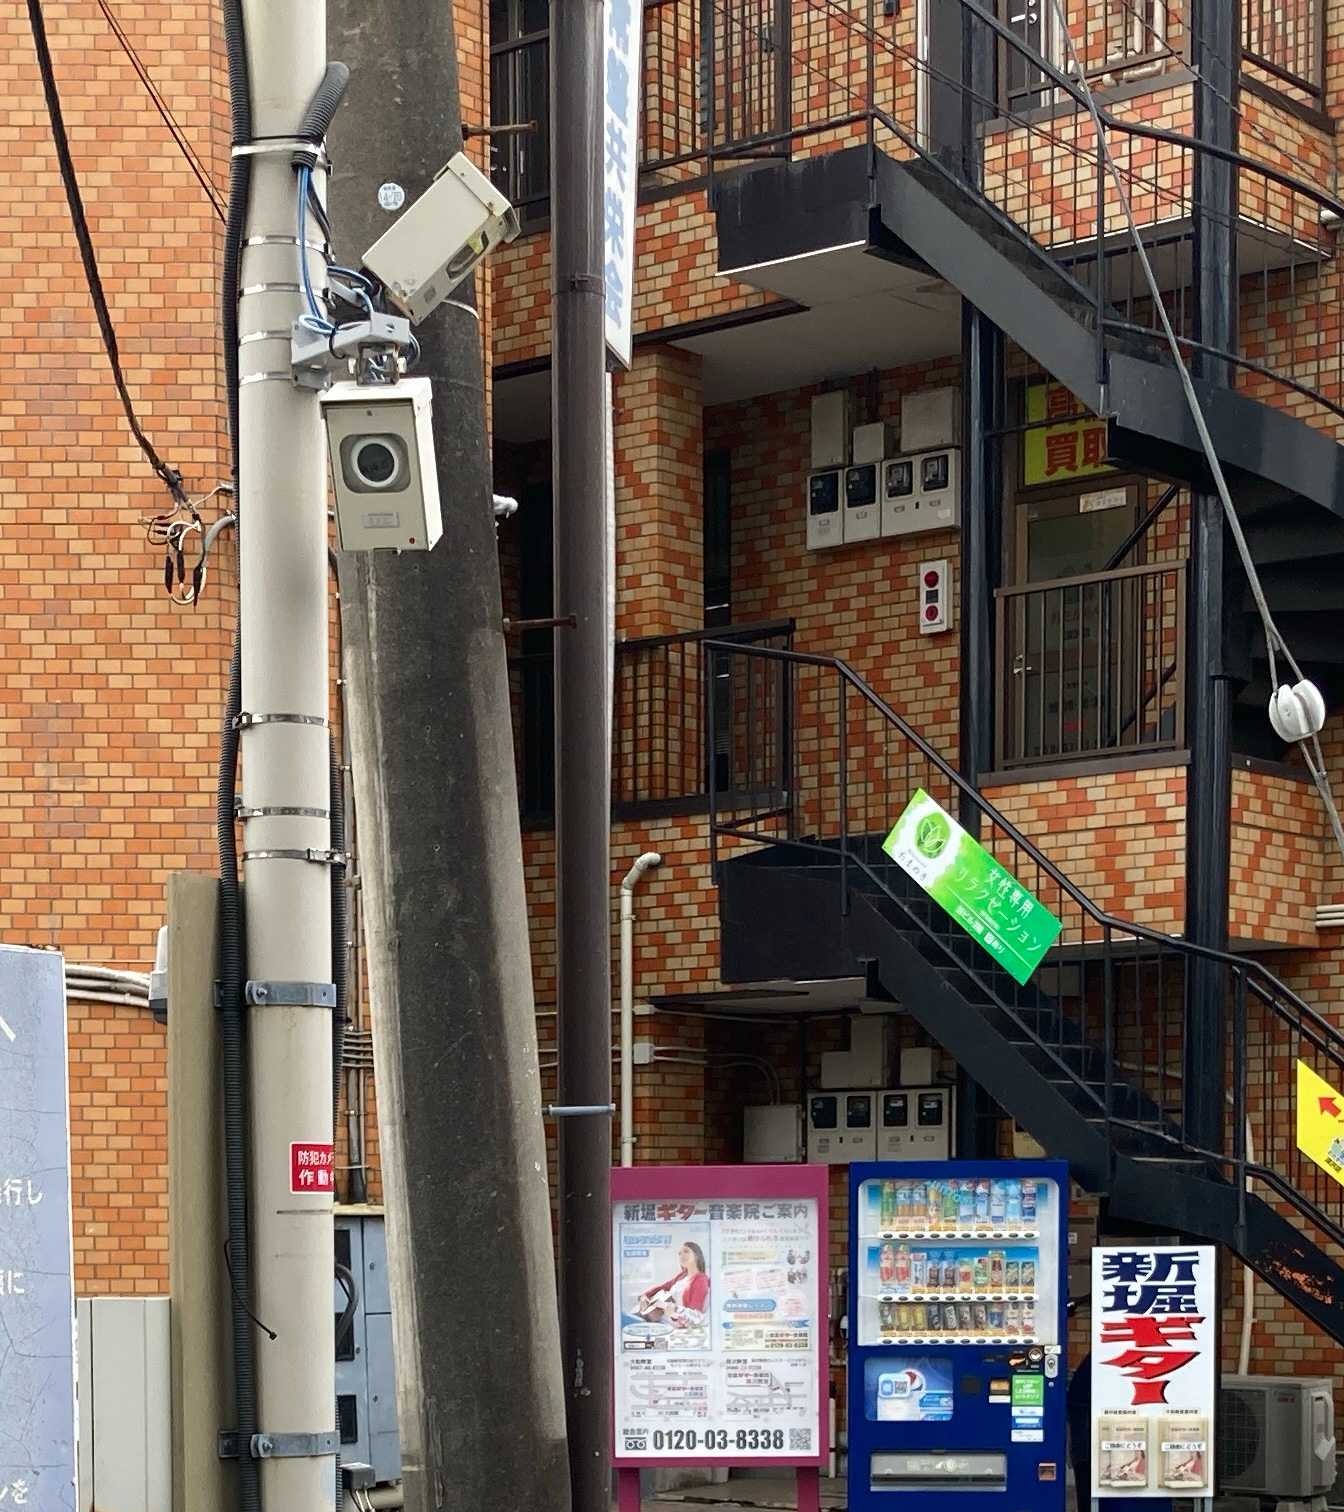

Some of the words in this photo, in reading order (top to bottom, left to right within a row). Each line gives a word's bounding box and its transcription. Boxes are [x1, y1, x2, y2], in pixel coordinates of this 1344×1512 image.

[954, 867, 1042, 951] リラクゼーション
[623, 1202, 808, 1222] 新堀ギター音楽院ご案内
[1099, 1251, 1206, 1406] 新堀ギター
[653, 1429, 784, 1450] 0120-03-8338
